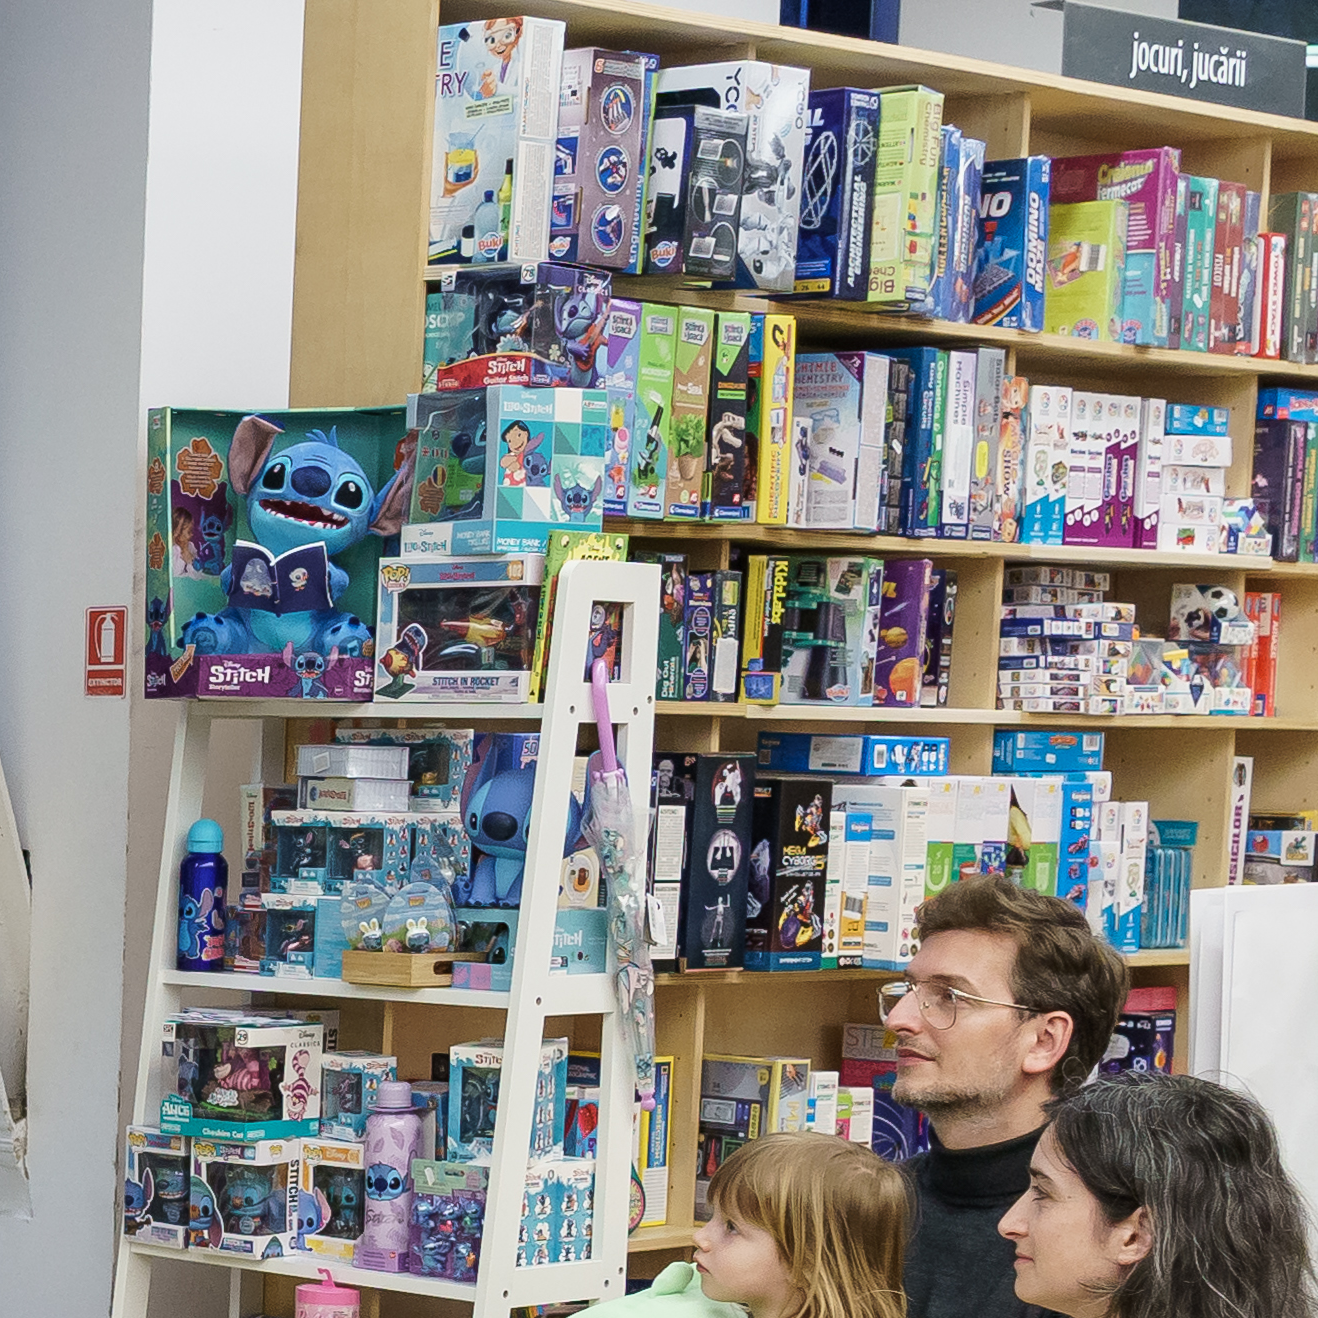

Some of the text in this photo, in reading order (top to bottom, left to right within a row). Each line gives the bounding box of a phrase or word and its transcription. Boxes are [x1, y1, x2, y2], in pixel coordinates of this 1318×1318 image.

[1130, 33, 1248, 88] jocuri, jucării
[920, 102, 932, 167] Chemistry
[847, 174, 862, 287] ARCHITECTURAL
[854, 181, 867, 275] ENGINEERING
[1026, 192, 1040, 284] DOMINO
[1034, 239, 1045, 293] MAZE
[1270, 254, 1280, 337] TOWER STACK
[935, 361, 944, 419] Genetics
[953, 360, 963, 425] Machines
[961, 380, 970, 426] Simple
[1003, 450, 1013, 497] SHOW
[497, 538, 519, 546] MONEY
[381, 565, 409, 582] POP!
[288, 1160, 299, 1203] STITCH
